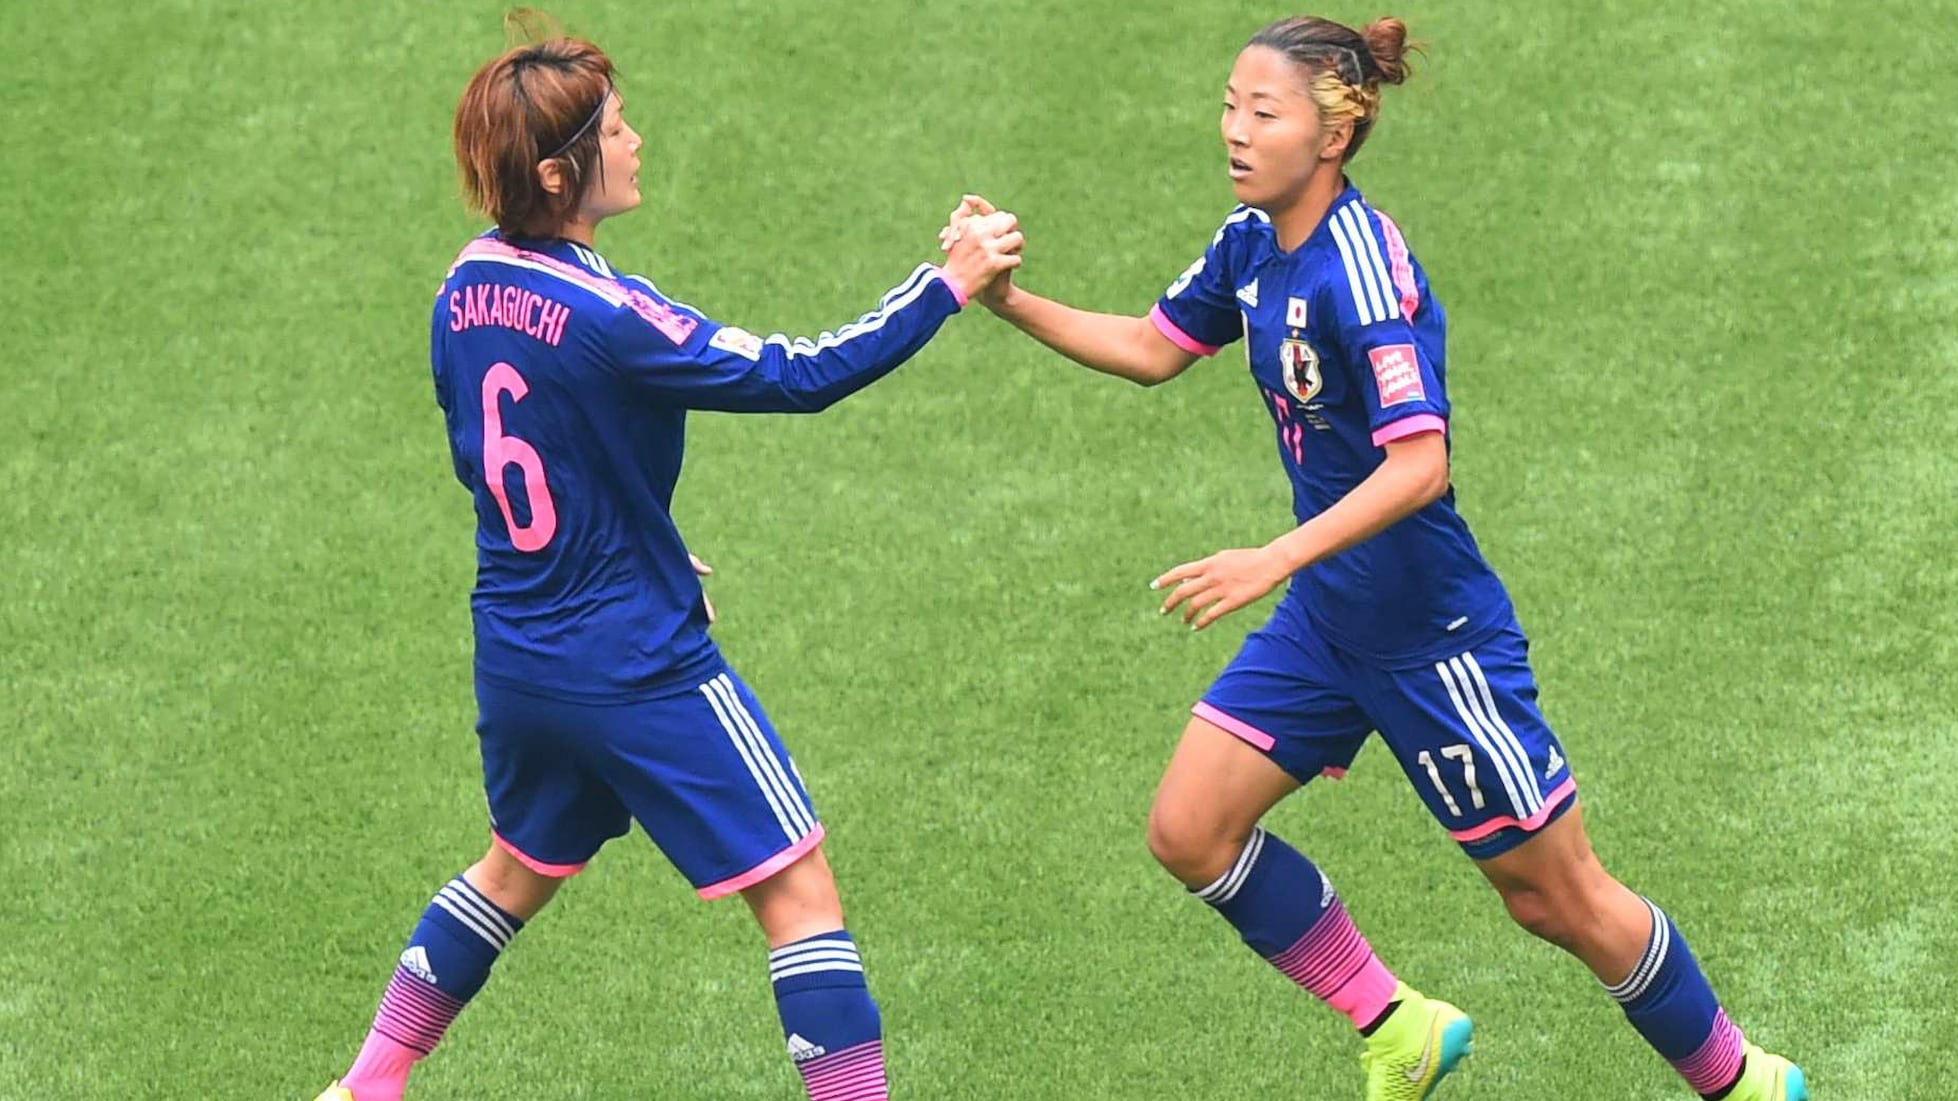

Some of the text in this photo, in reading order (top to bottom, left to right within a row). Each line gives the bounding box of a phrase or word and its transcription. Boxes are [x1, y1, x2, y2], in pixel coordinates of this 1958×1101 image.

[449, 283, 570, 347] SAKAGUCHI
[482, 362, 557, 553] 6
[1418, 744, 1485, 817] 17
